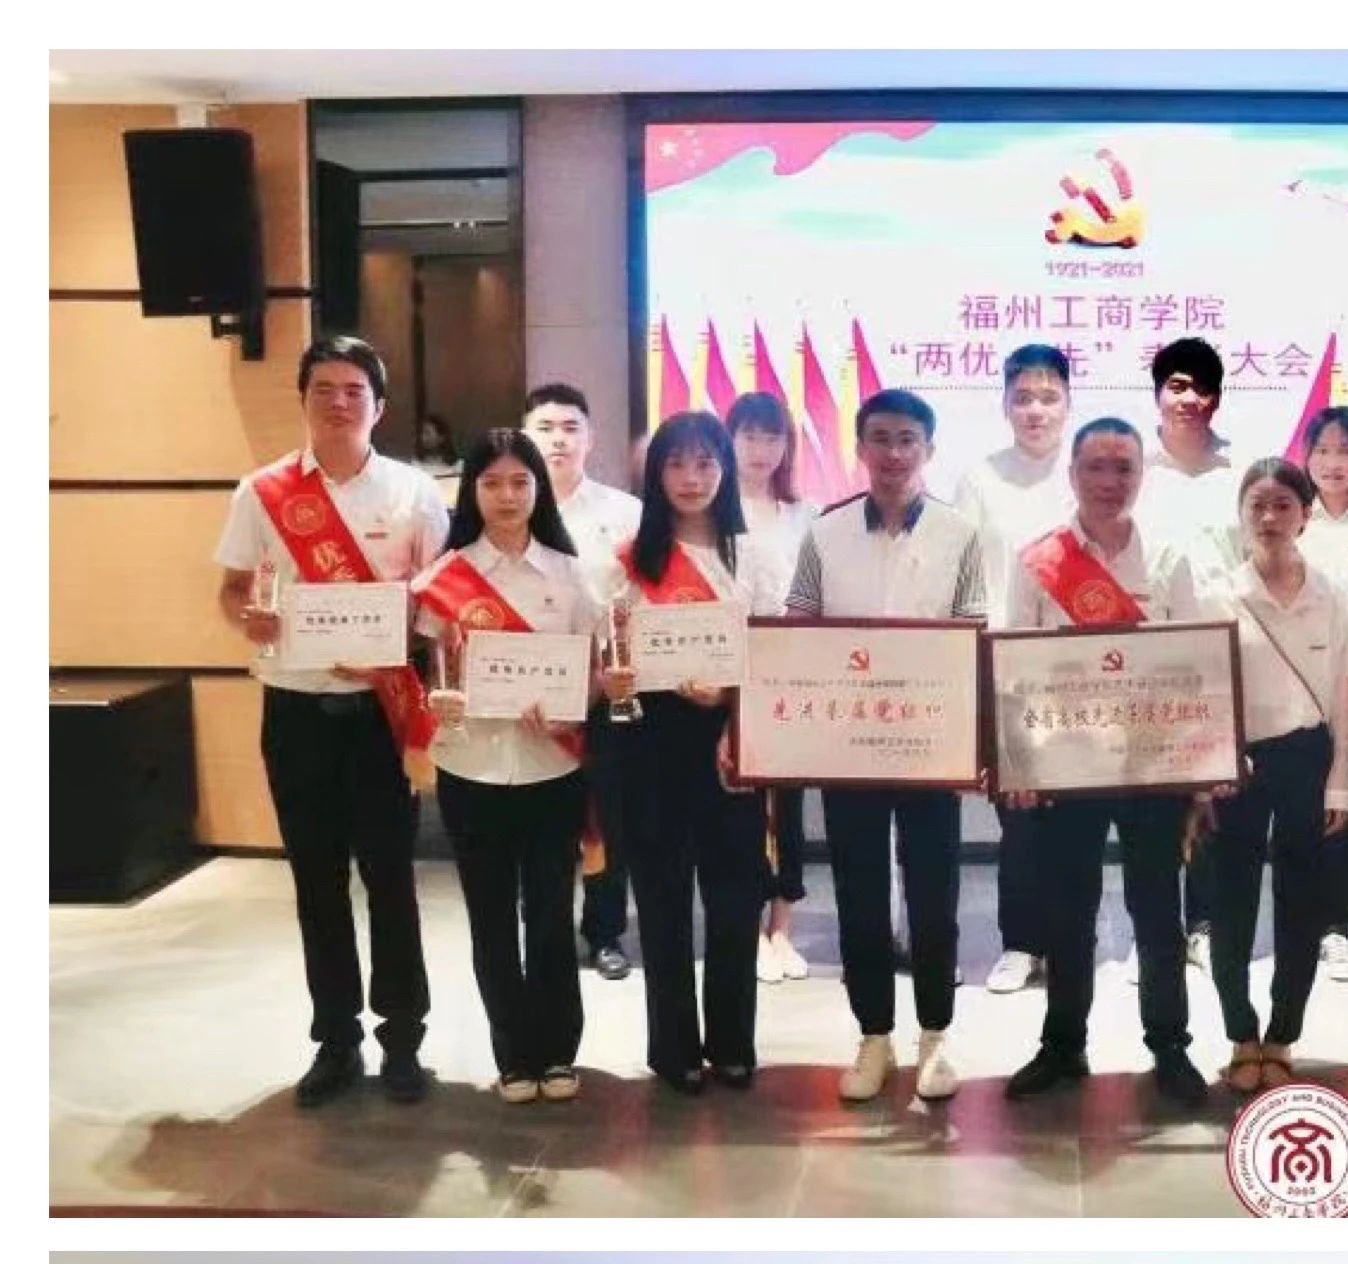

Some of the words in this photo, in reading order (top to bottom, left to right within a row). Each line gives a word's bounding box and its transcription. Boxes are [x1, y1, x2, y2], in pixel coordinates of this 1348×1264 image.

[959, 294, 1225, 330] 福州工商学院
[1141, 342, 1313, 377] 大会
